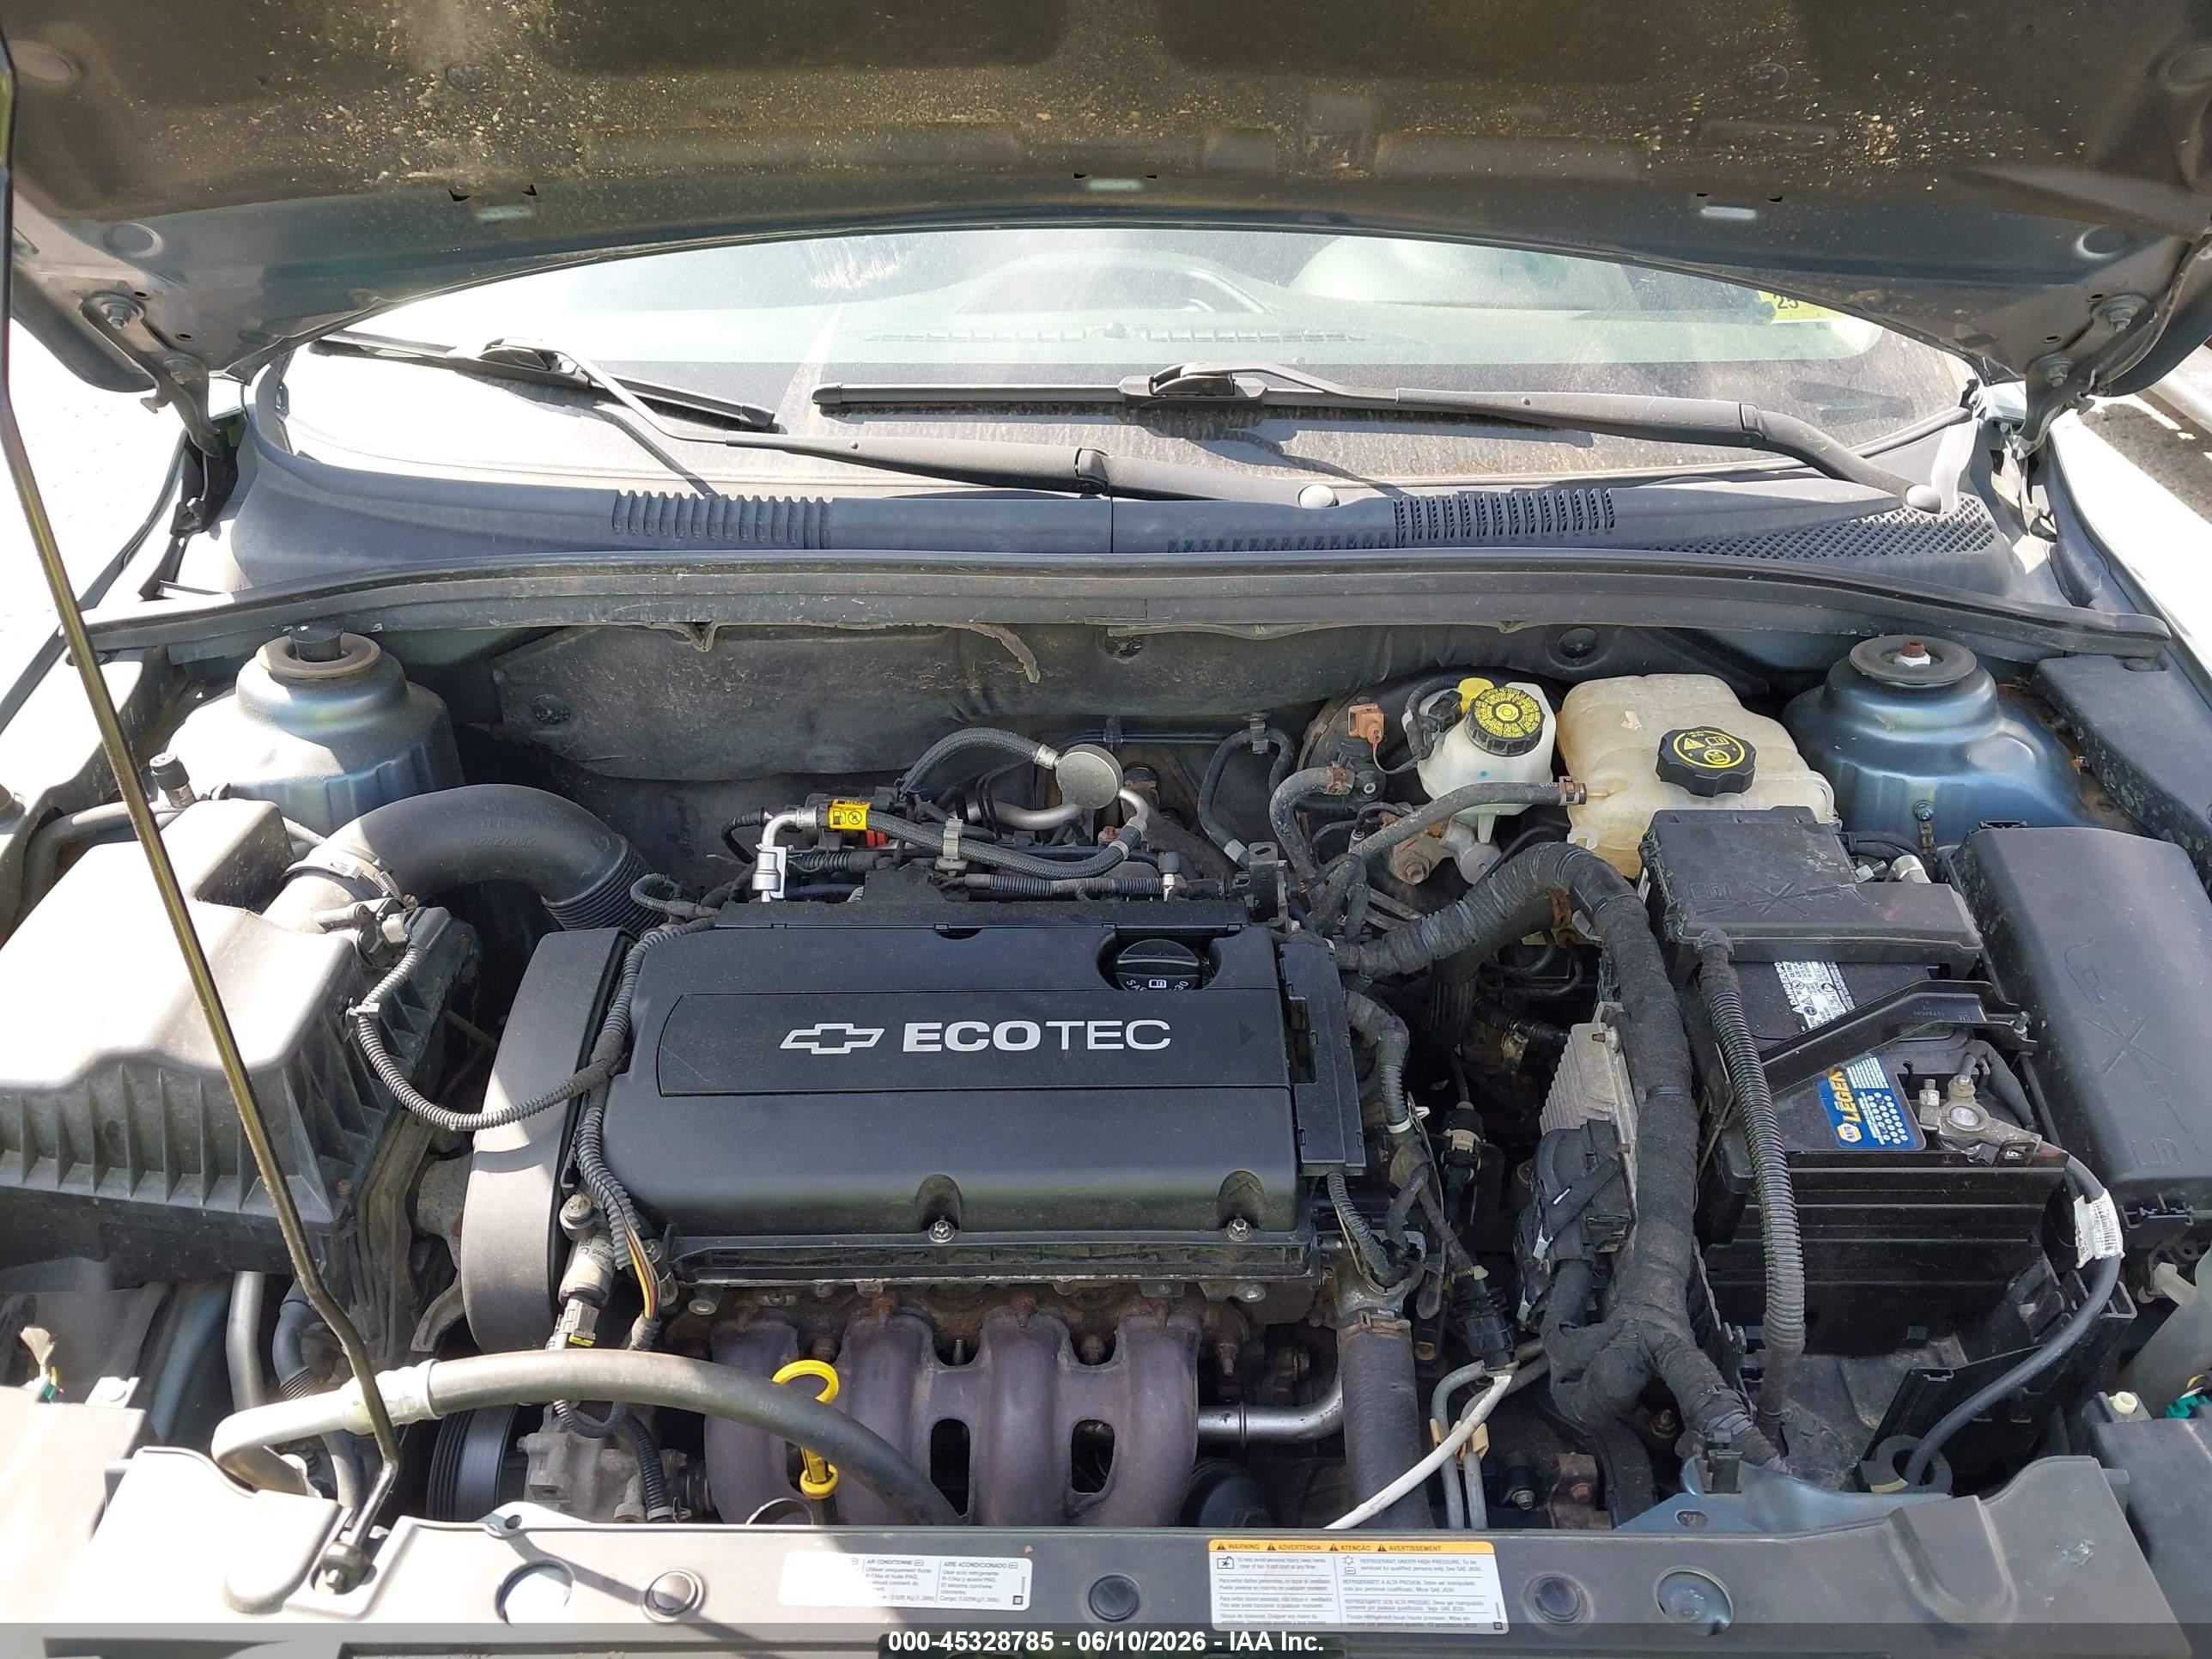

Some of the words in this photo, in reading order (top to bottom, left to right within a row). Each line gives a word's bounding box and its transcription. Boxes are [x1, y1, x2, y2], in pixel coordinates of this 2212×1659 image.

[1774, 962, 1799, 1006] DANGER/PO
[902, 1019, 1170, 1052] ECOTEC
[1828, 1071, 1862, 1123] LEGEN
